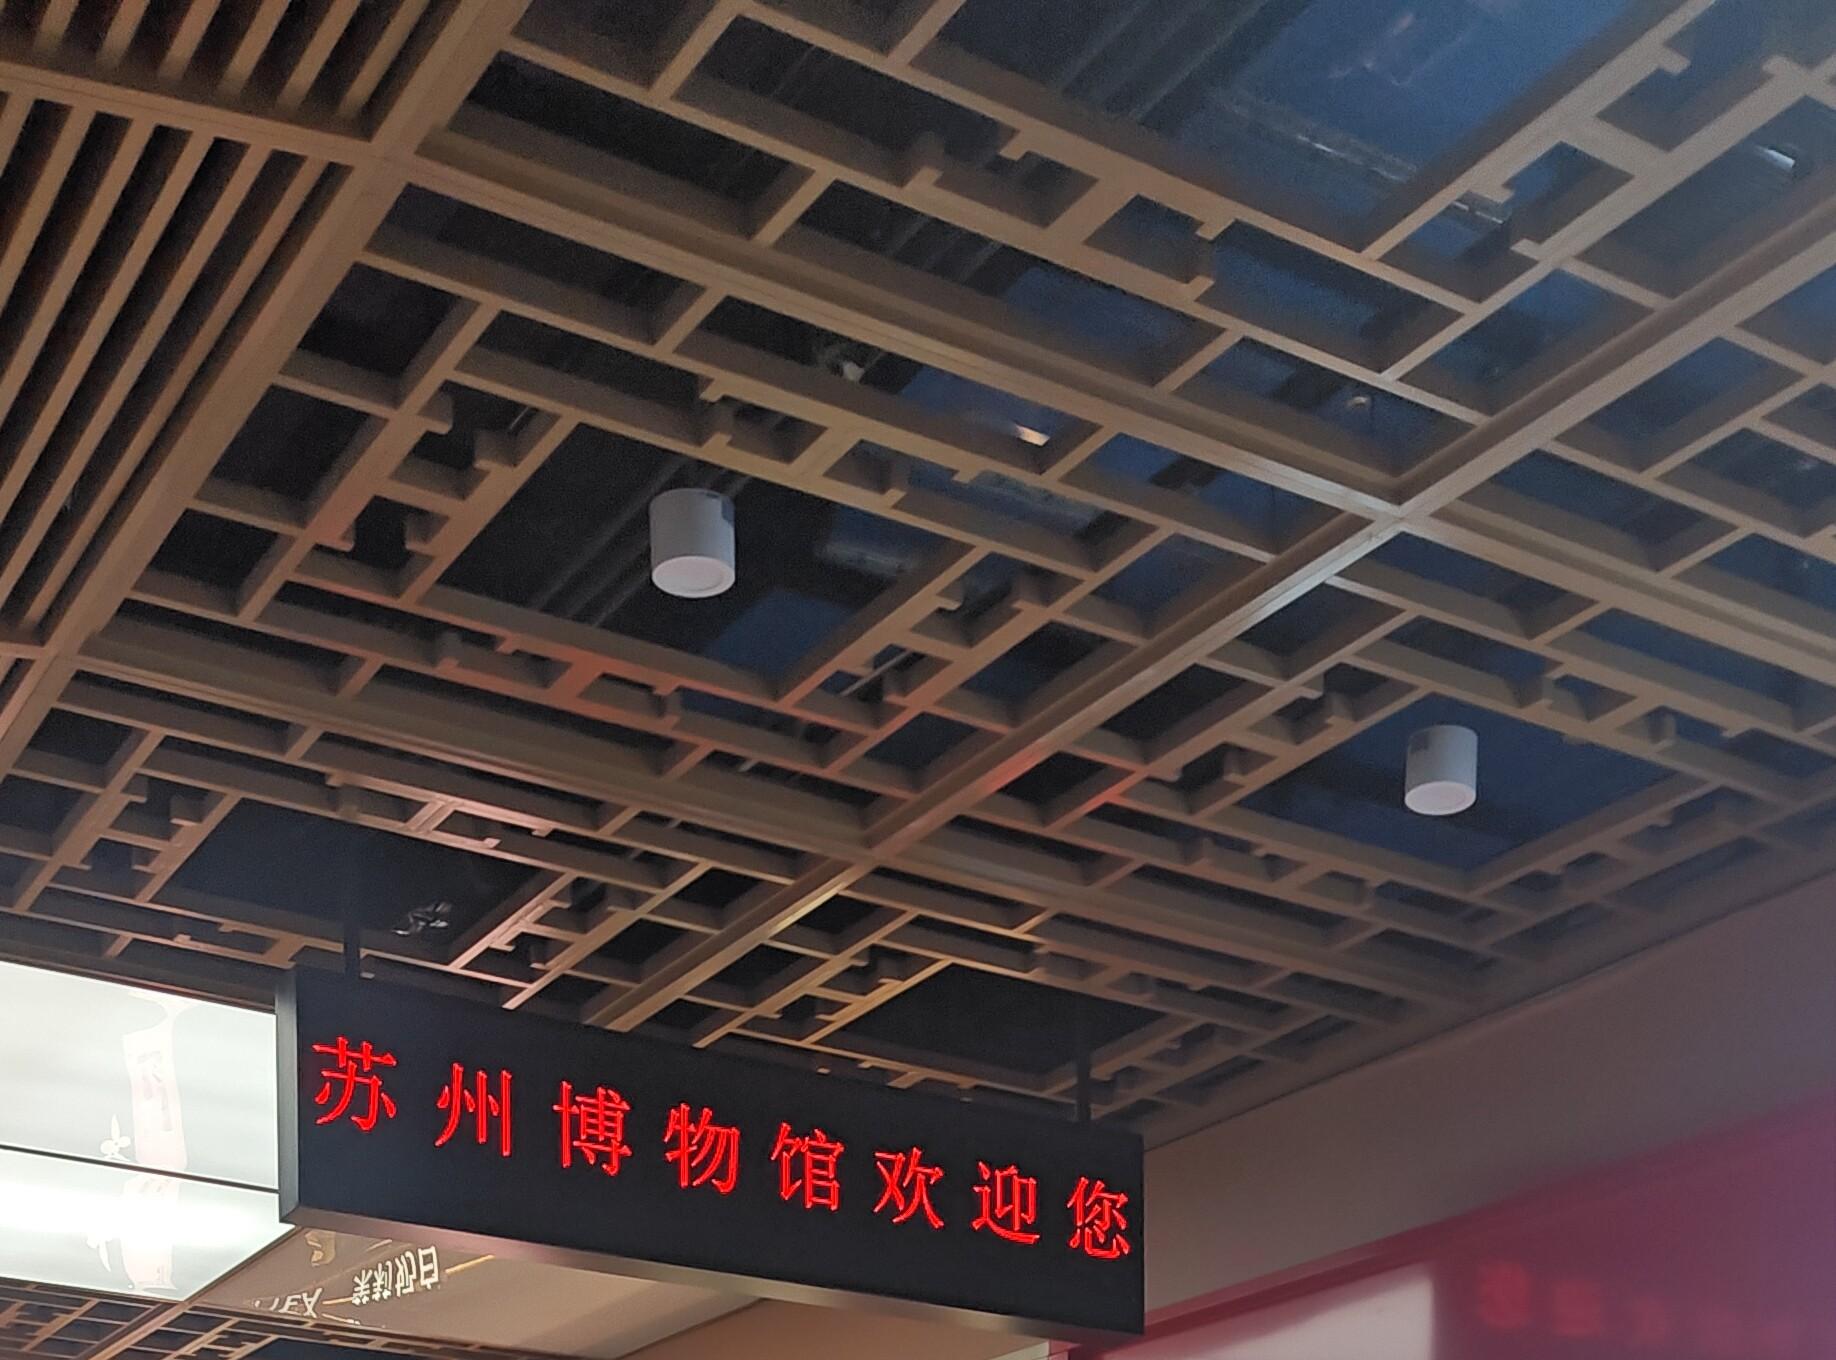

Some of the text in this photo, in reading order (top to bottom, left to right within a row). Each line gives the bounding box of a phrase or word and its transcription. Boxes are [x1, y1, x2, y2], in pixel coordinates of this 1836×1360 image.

[311, 1035, 1132, 1260] 苏州博物馆欢迎您
